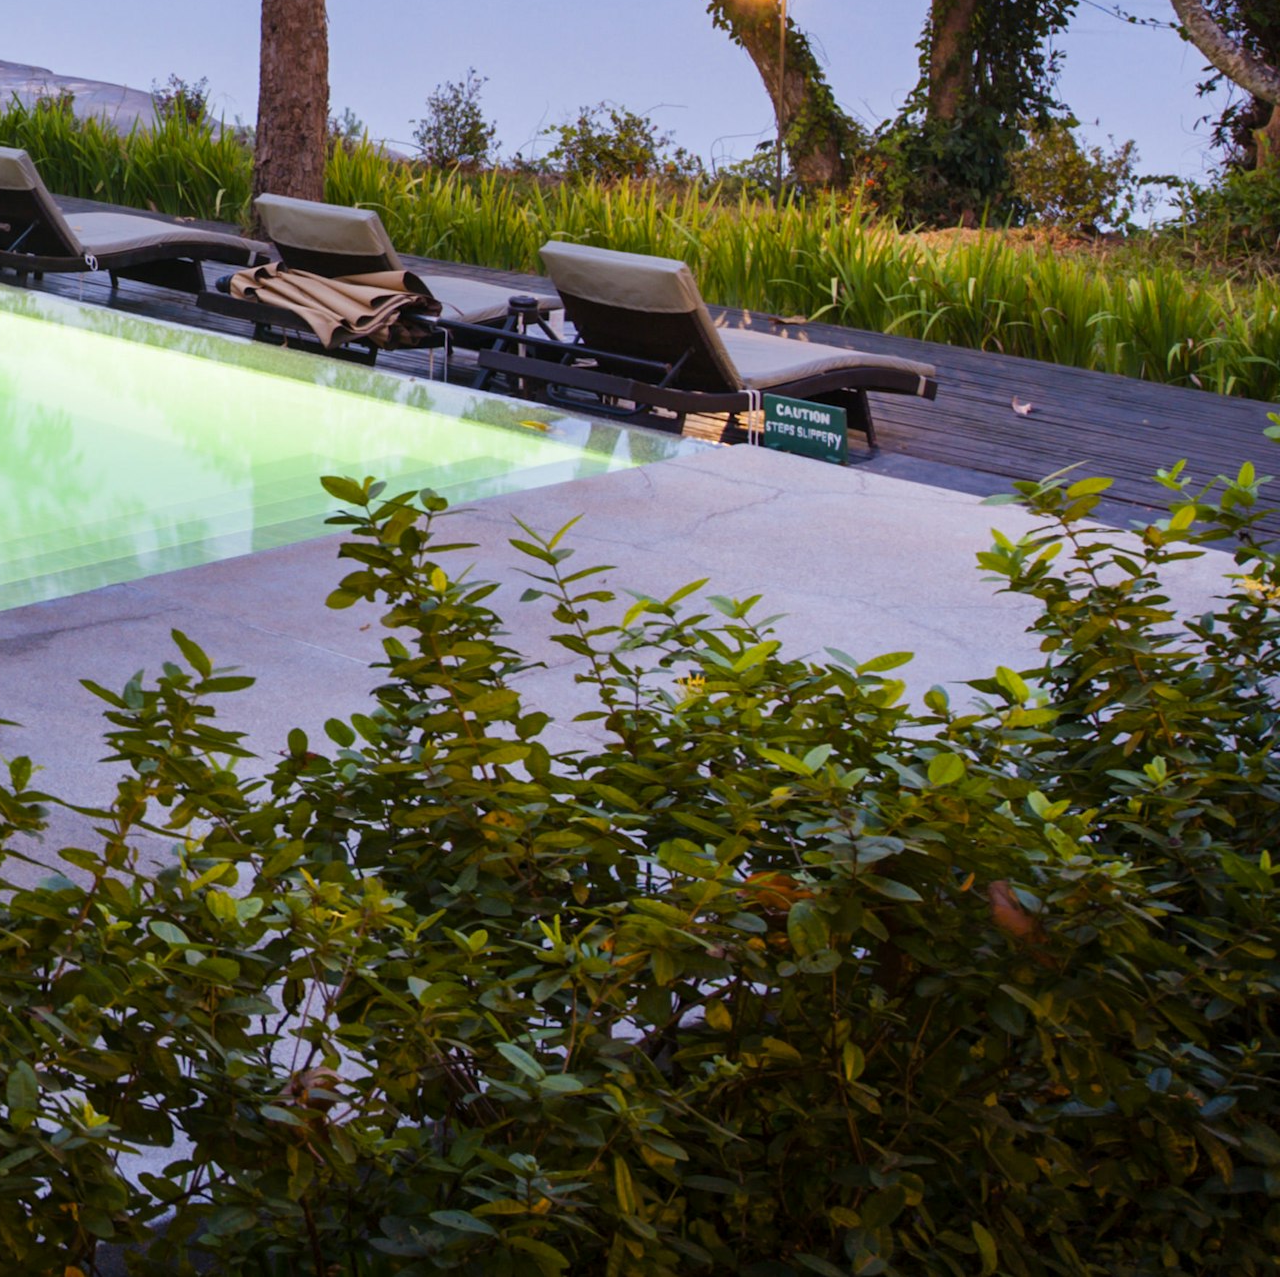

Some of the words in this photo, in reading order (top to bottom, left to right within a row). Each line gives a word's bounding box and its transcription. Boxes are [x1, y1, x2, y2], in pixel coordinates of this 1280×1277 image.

[776, 403, 830, 425] CAUTION
[766, 421, 795, 436] STEPS
[796, 426, 842, 450] SLIPPERY
